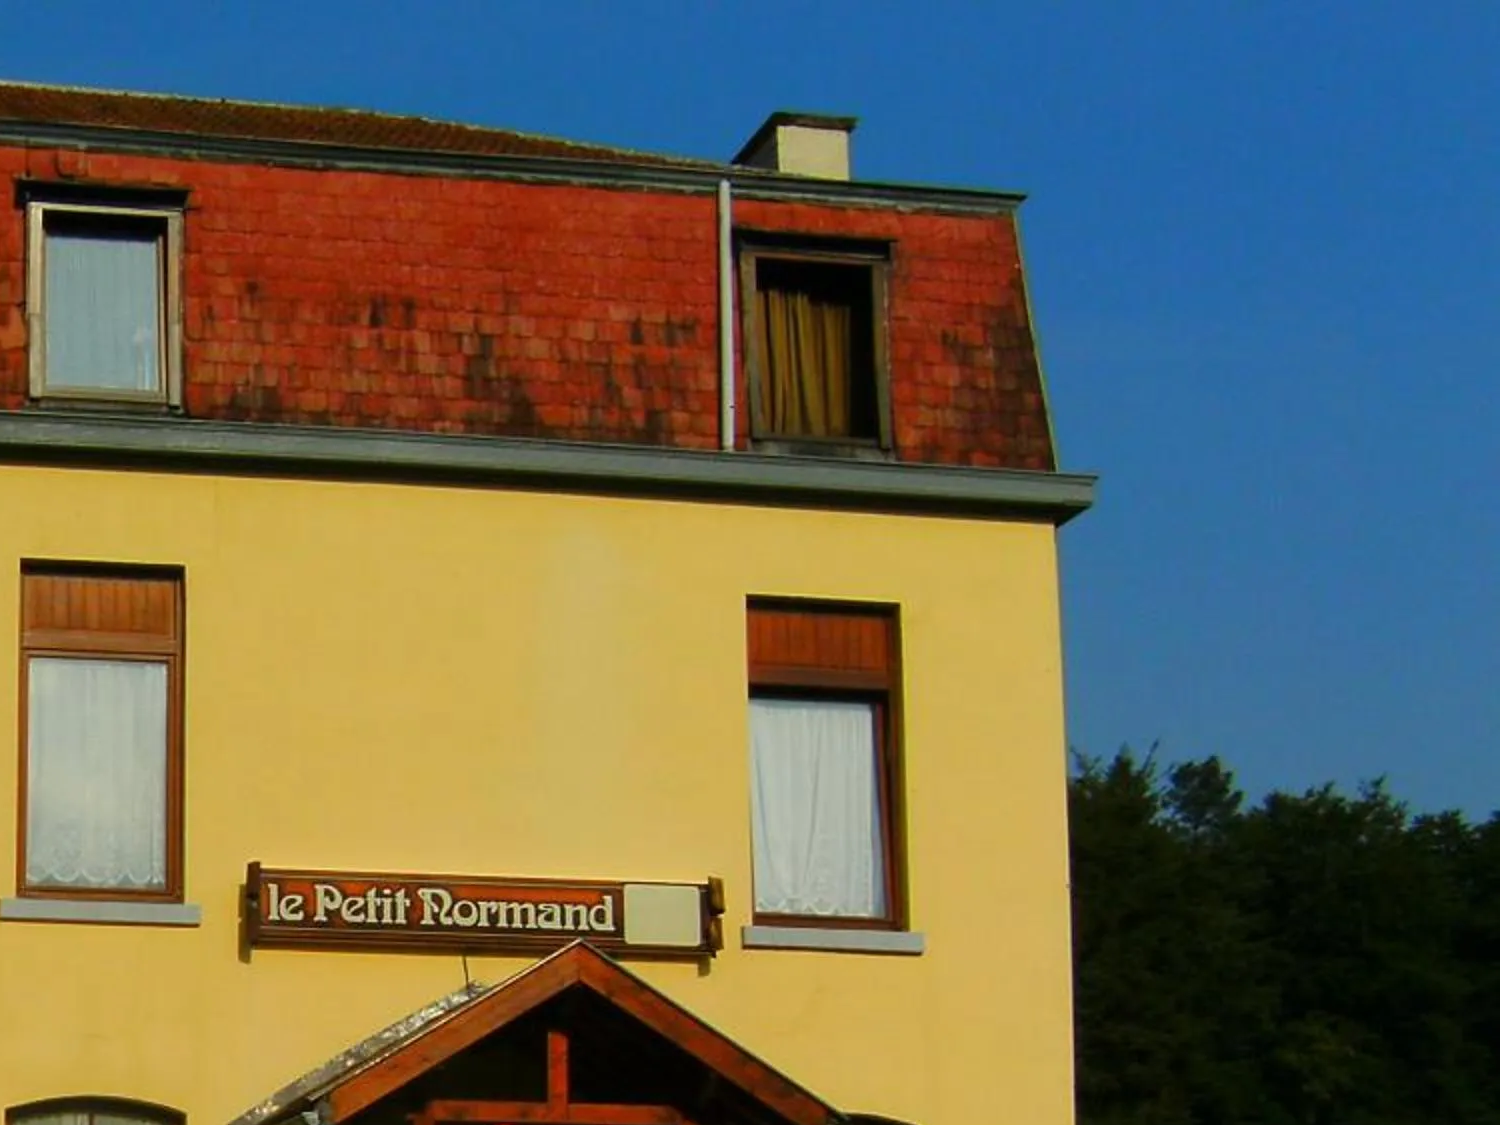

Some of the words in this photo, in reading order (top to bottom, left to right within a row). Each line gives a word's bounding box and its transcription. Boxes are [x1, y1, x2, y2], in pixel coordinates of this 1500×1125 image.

[267, 883, 304, 921] le
[313, 883, 411, 925] Petit
[417, 887, 616, 932] Normand
